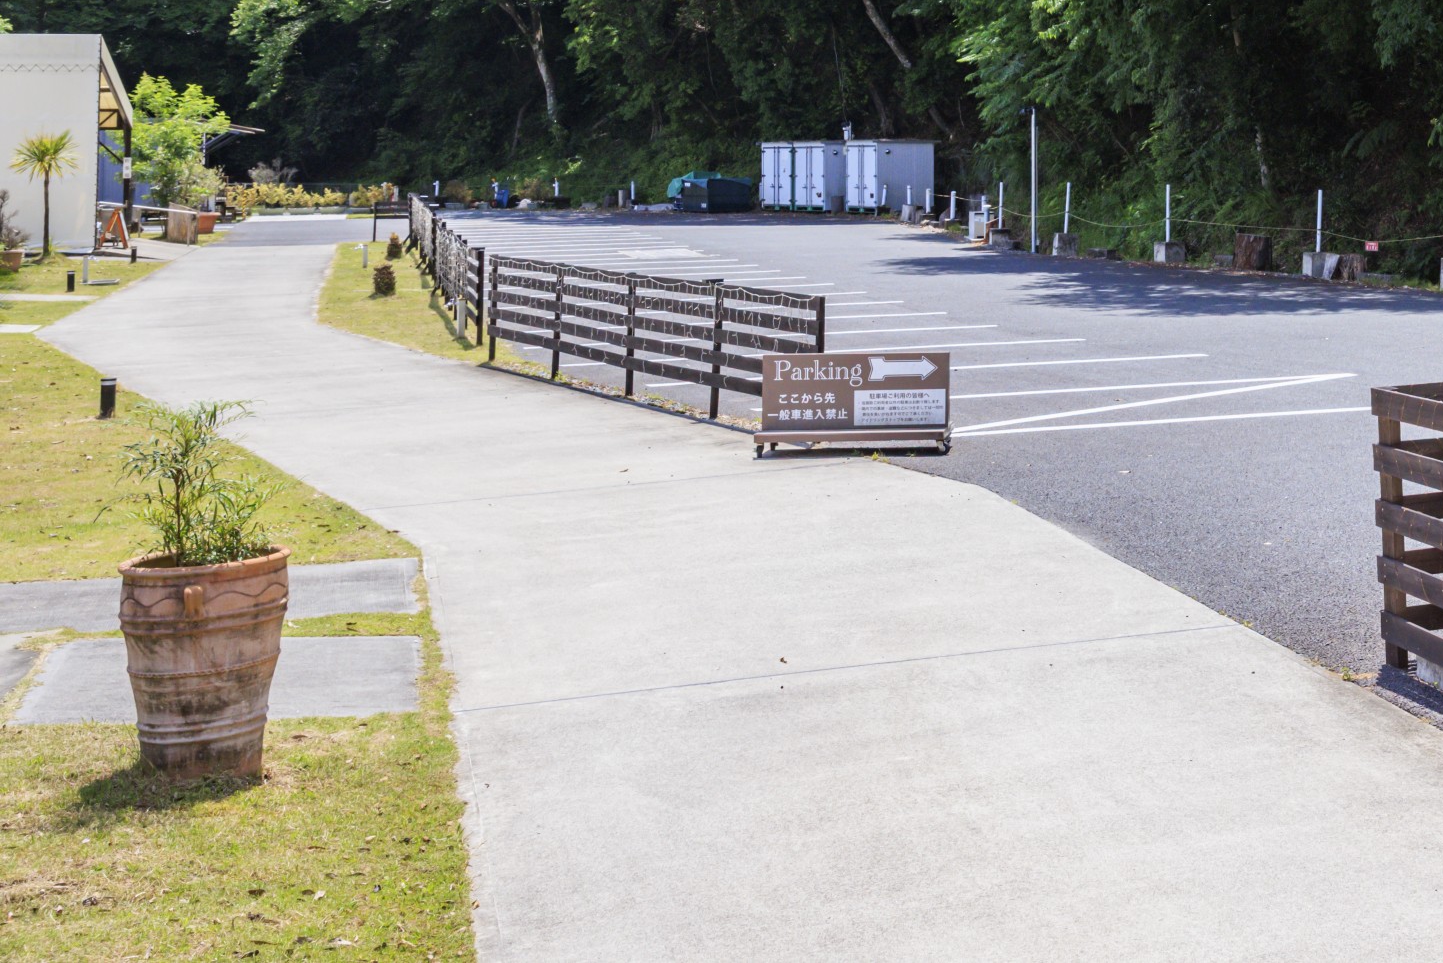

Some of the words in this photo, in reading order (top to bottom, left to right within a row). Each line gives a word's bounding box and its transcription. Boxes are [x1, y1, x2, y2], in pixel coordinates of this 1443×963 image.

[773, 359, 863, 387] Parking
[778, 392, 836, 404] ここから先
[767, 408, 849, 421] 一般車進入禁止
